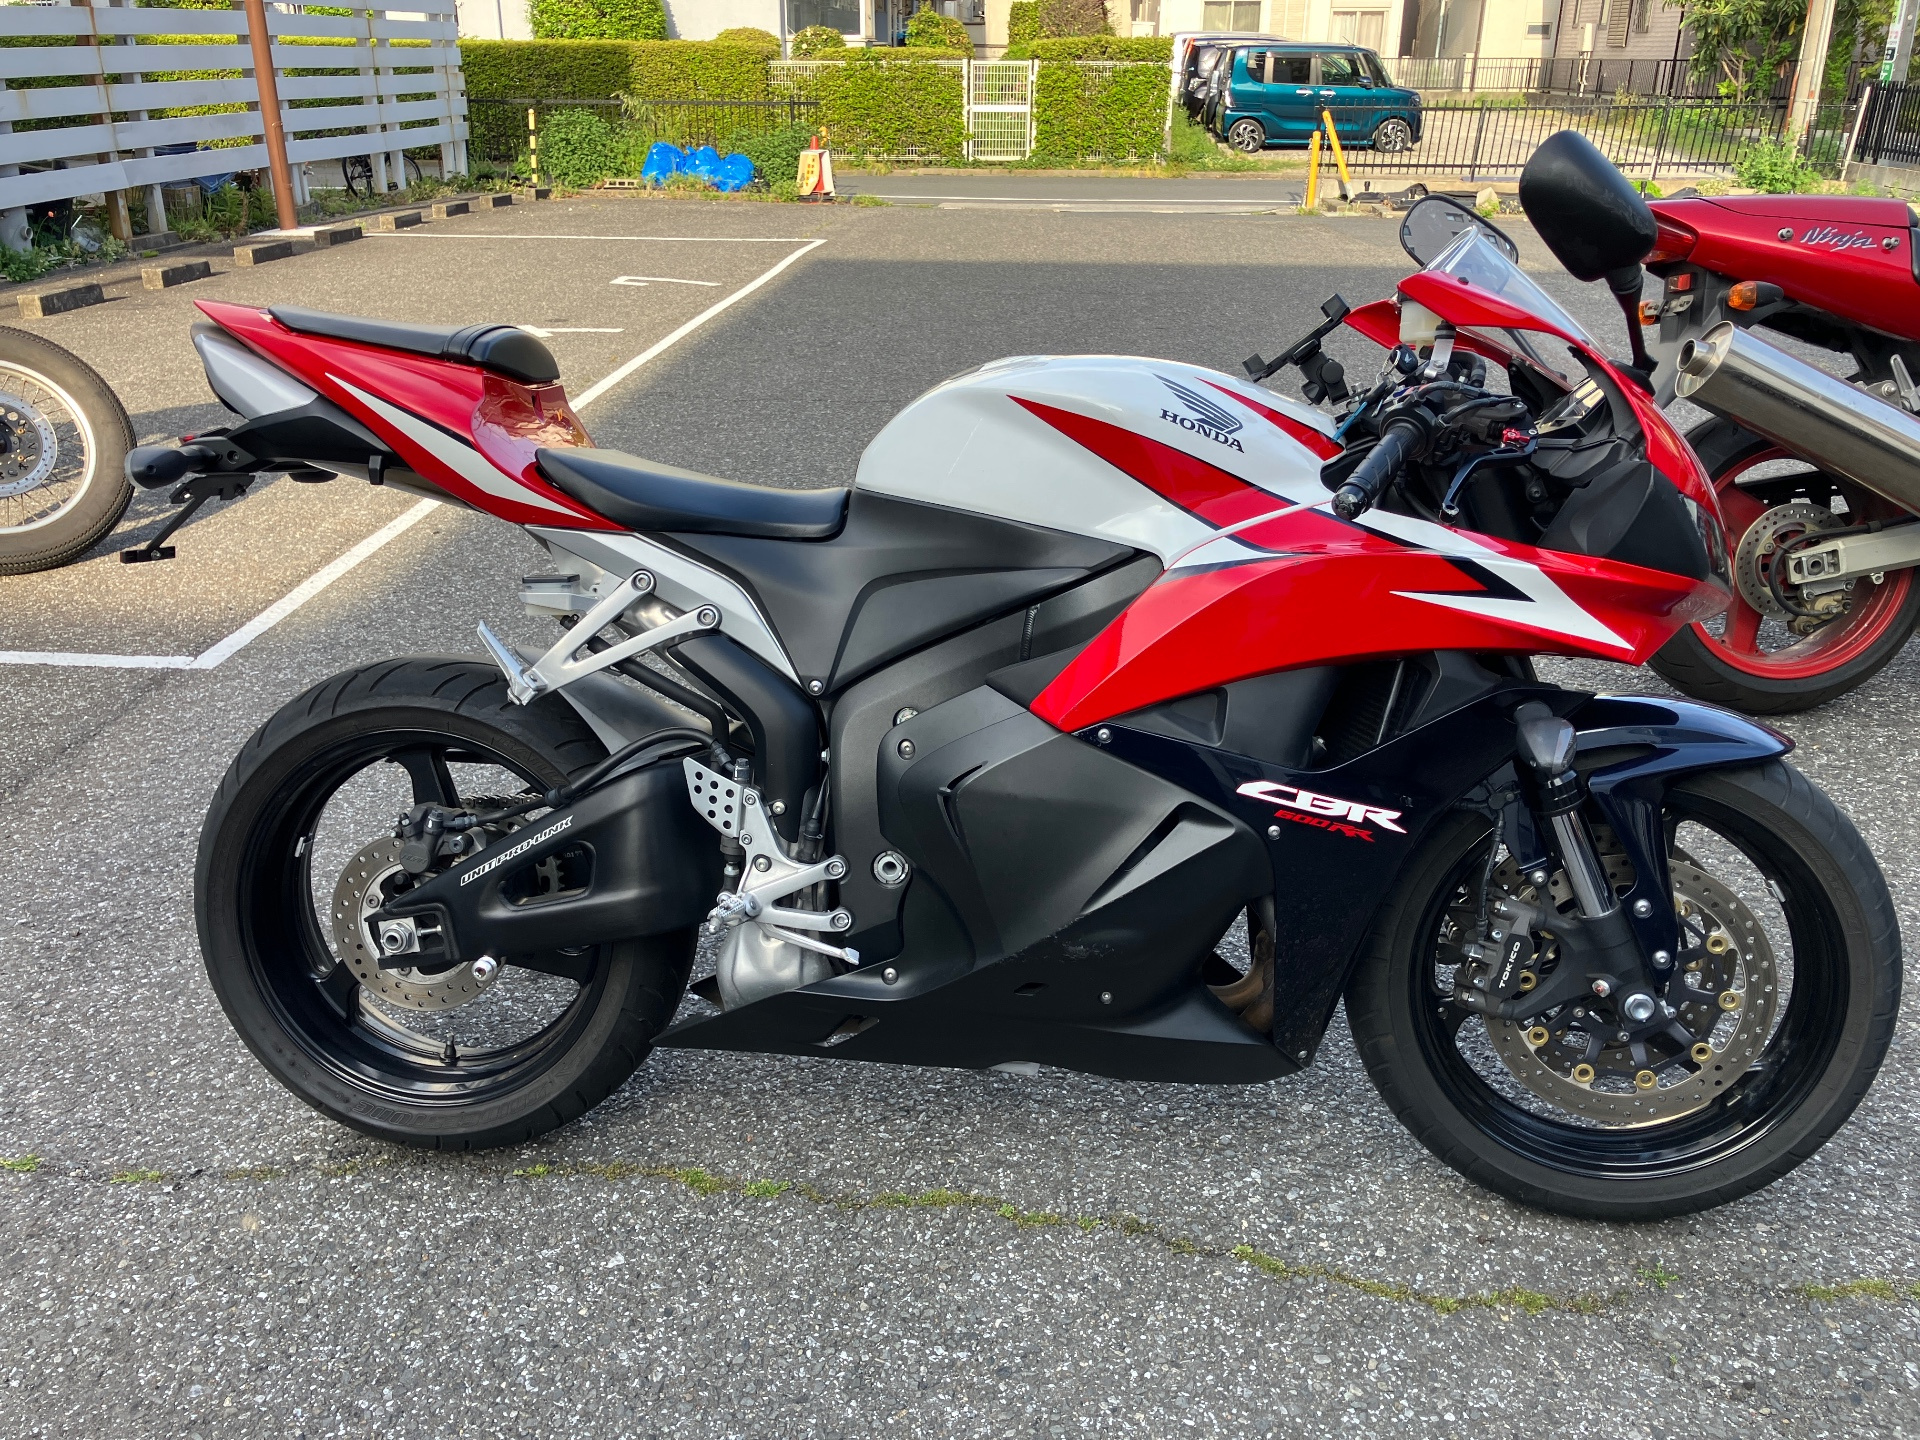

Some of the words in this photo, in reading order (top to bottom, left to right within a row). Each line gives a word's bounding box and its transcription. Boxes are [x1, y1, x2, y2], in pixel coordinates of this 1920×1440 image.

[1800, 227, 1877, 252] Ninja
[1159, 408, 1245, 454] HONDA
[1235, 780, 1408, 834] CBR
[1273, 809, 1376, 843] 600RR
[460, 857, 497, 887] UNIT
[1498, 941, 1521, 989] TOKICO
